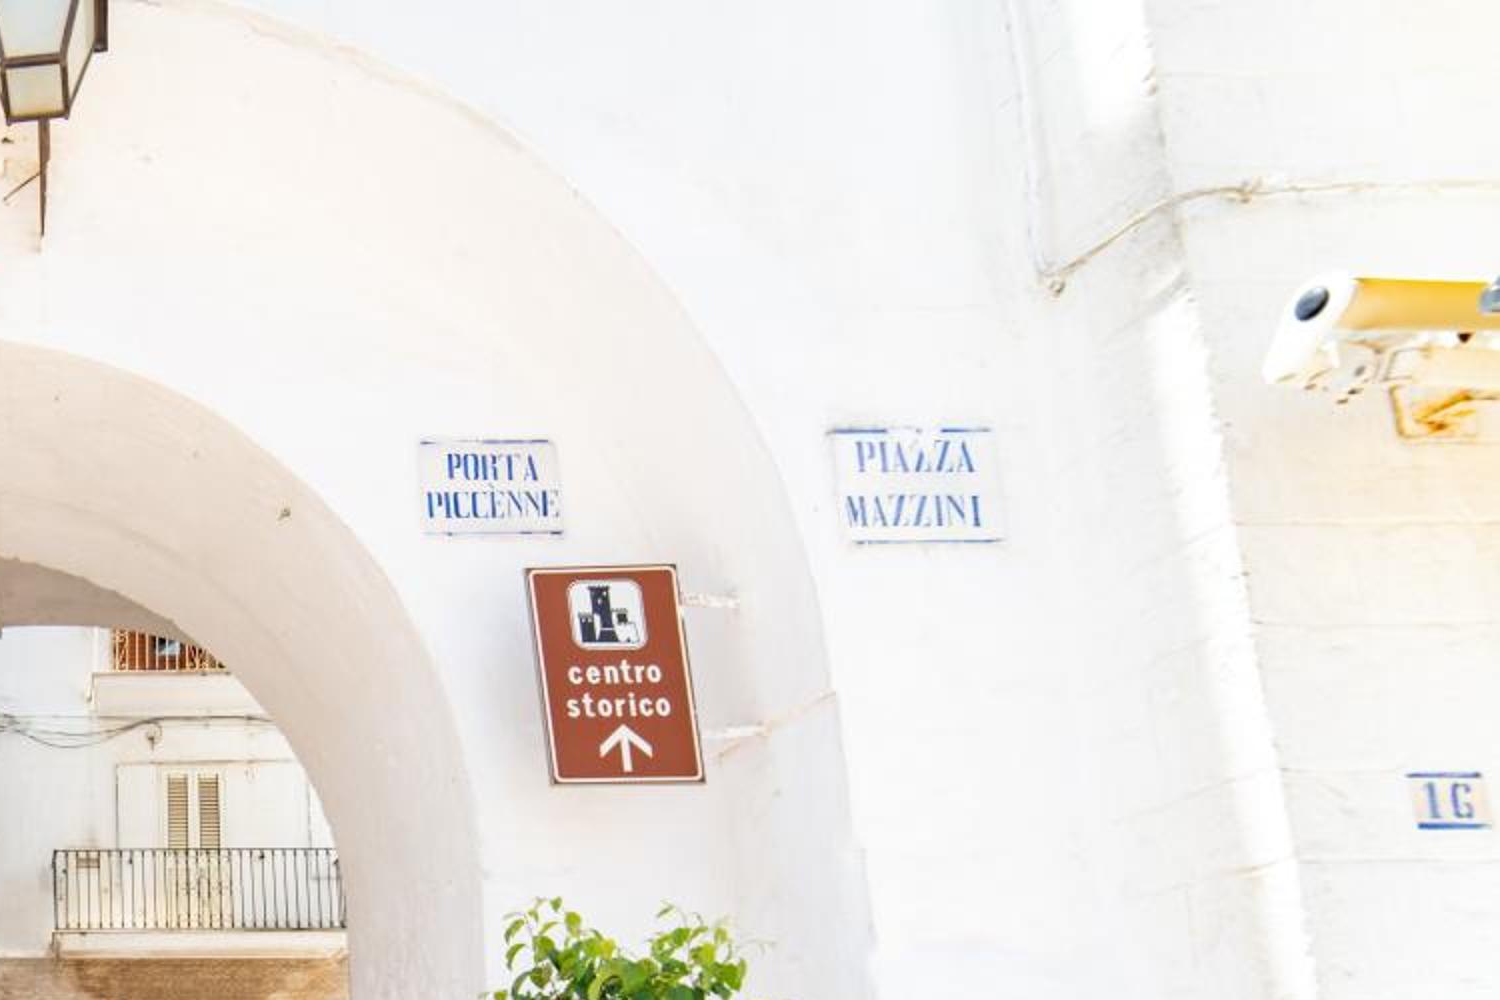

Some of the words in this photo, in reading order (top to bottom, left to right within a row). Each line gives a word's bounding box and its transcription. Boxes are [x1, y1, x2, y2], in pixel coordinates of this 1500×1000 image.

[445, 453, 538, 480] PORTA
[855, 440, 975, 472] PIAZZA
[846, 495, 981, 526] MAZZINI
[567, 659, 662, 685] centro
[566, 691, 671, 718] storico
